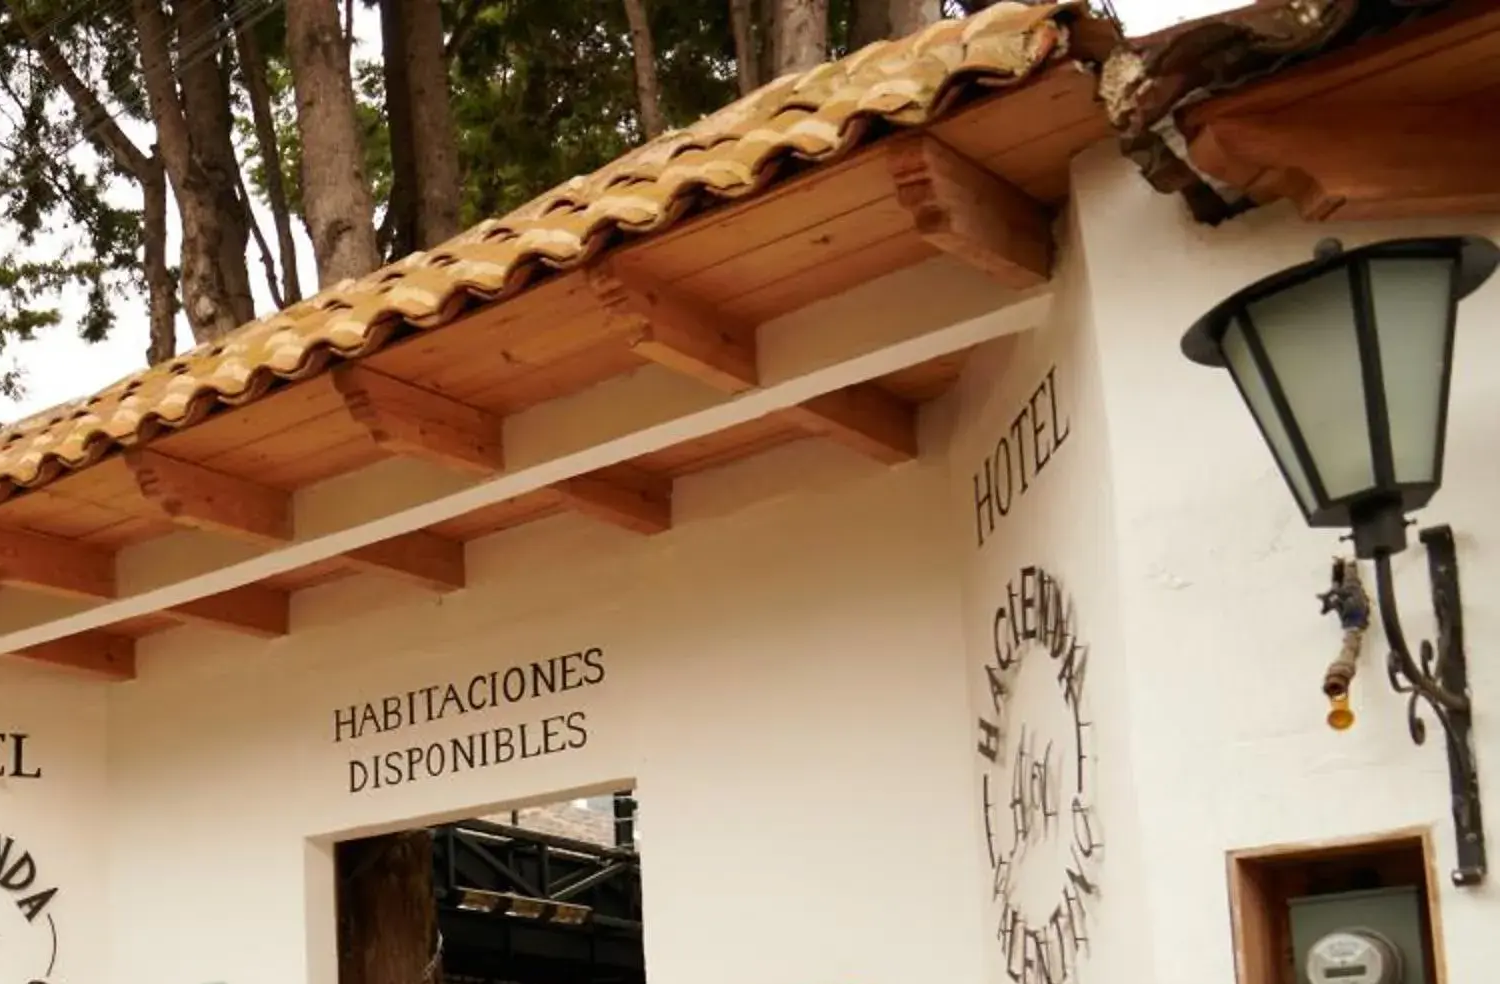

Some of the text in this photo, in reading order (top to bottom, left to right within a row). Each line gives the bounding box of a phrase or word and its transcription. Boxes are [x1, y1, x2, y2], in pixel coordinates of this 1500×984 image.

[973, 364, 1070, 547] HOTEL
[333, 647, 606, 742] HABITACIONES
[348, 711, 588, 793] DISPONIBLES
